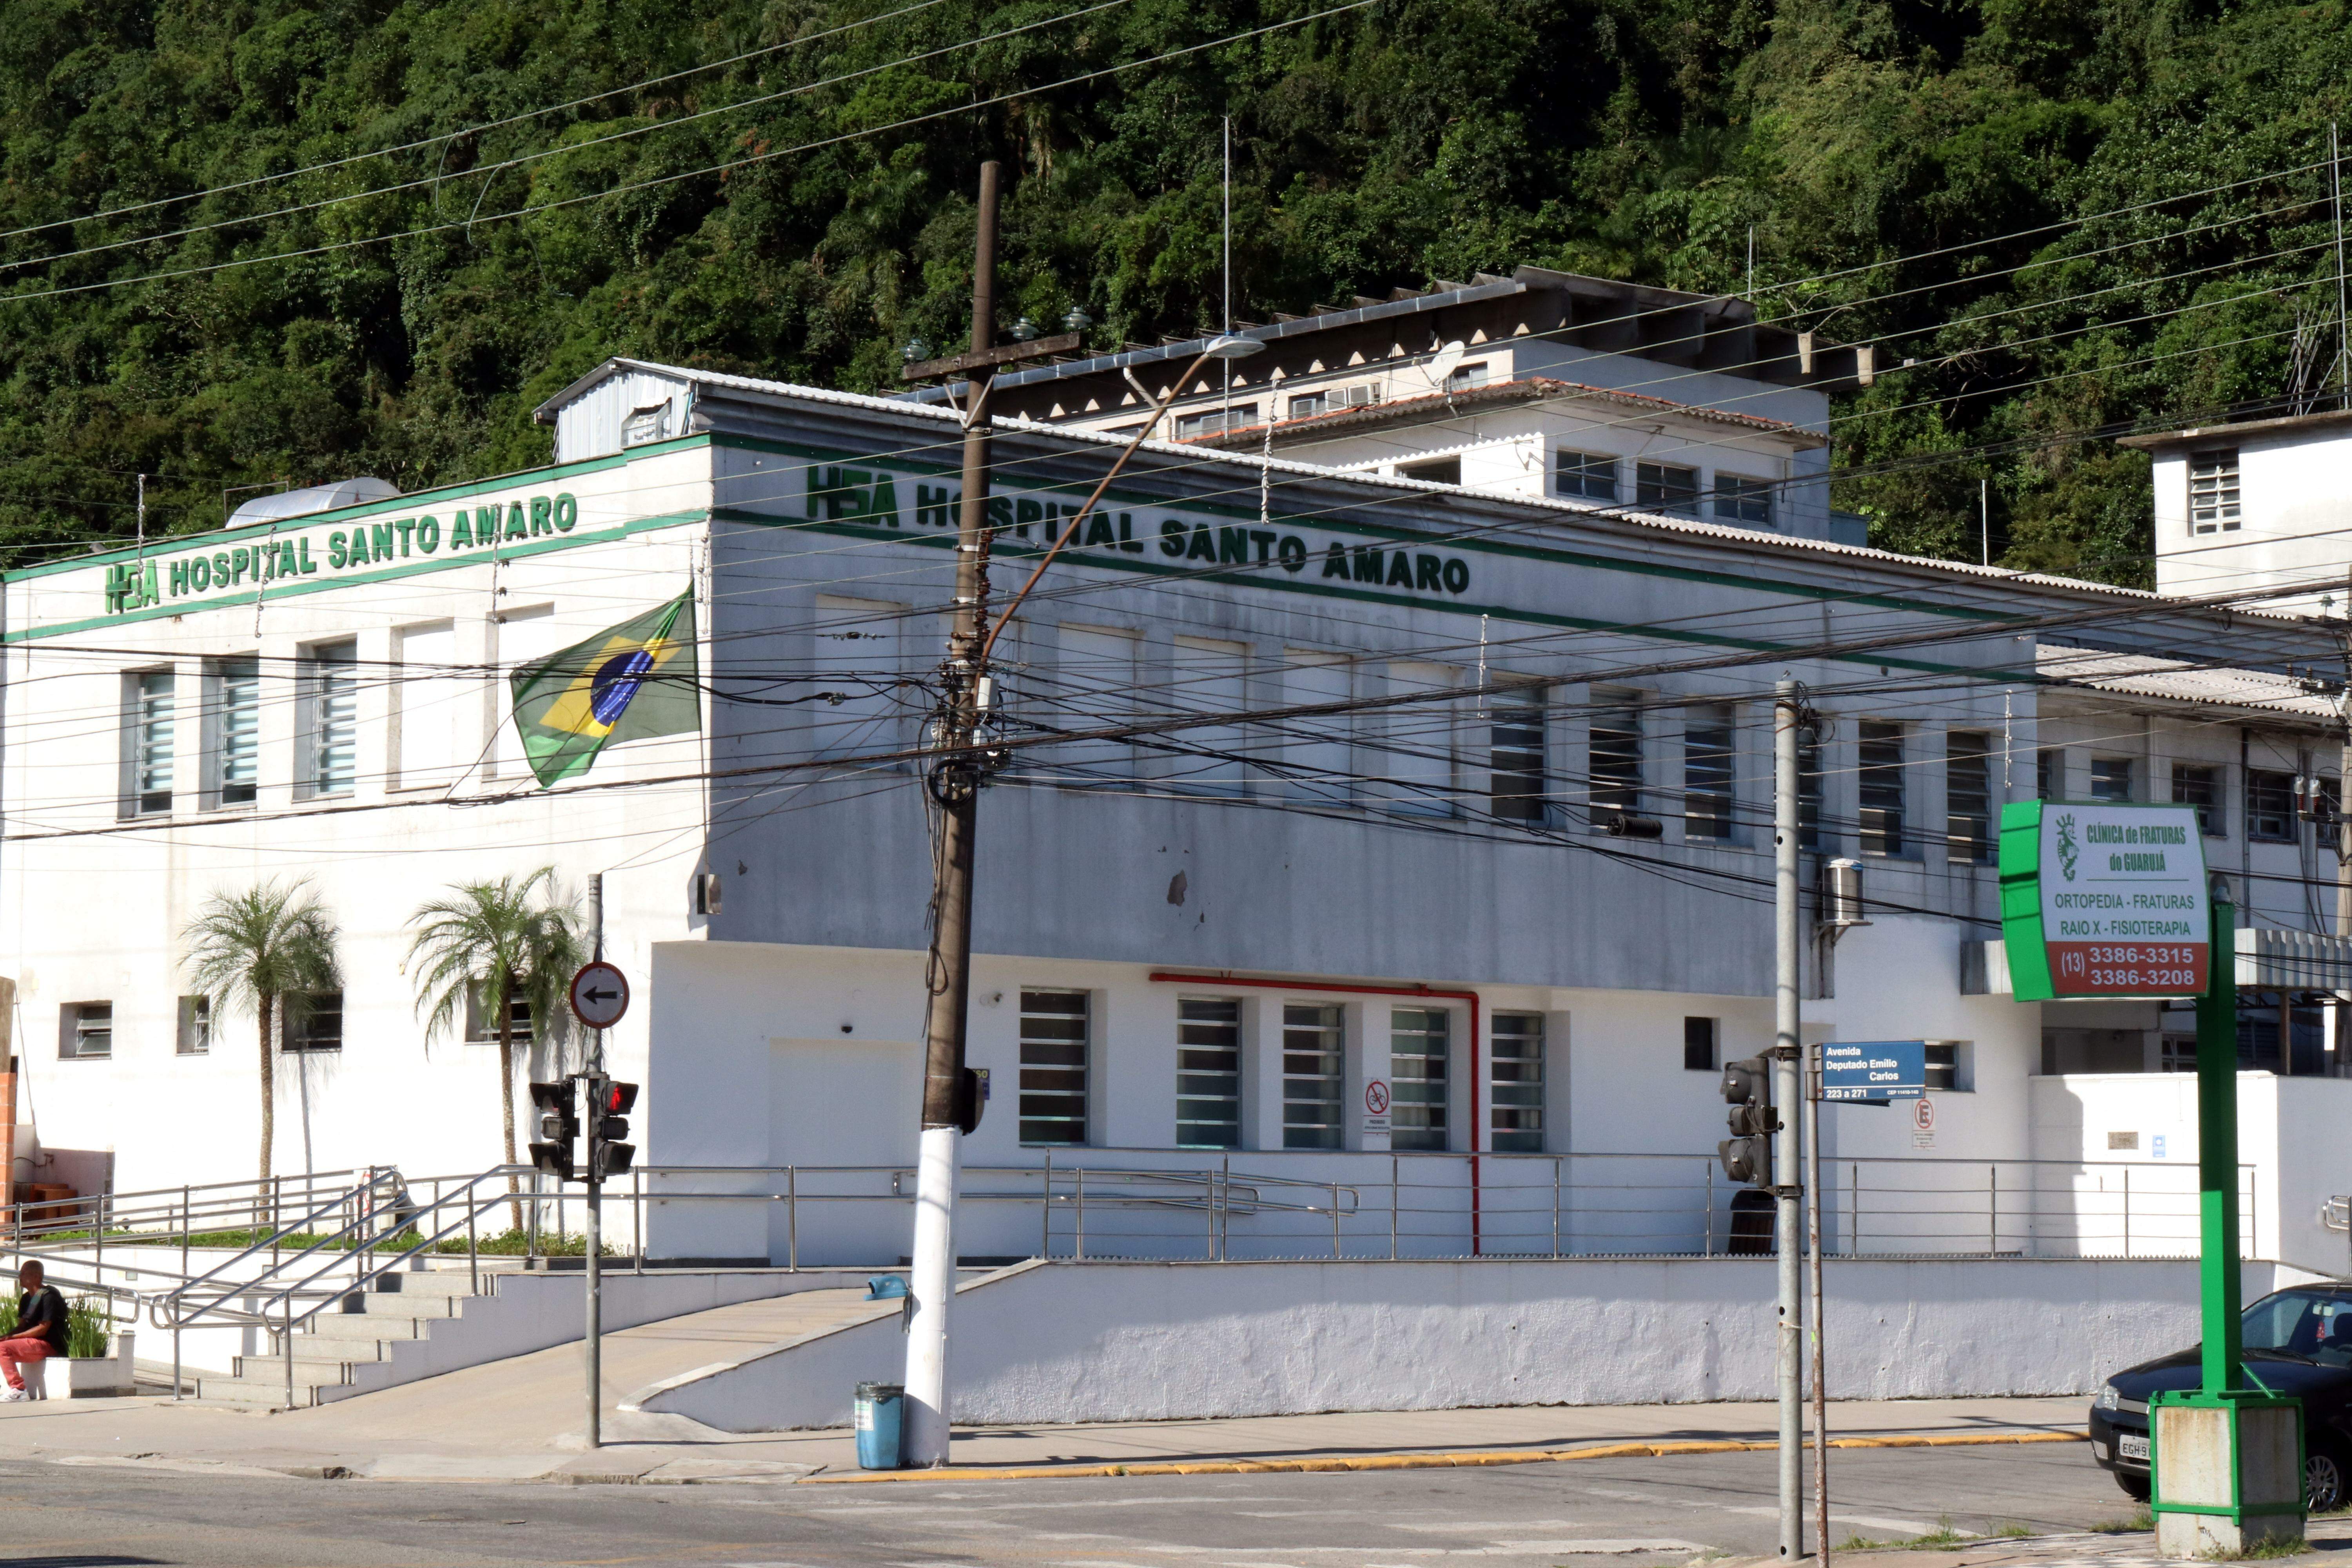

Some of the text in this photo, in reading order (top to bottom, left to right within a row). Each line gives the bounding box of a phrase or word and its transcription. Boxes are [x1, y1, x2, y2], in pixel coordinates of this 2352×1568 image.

[169, 537, 317, 597] HOSPITAL
[328, 515, 440, 568] SANTO
[450, 493, 577, 549] AMARO
[917, 484, 1143, 552] HSPITAL
[1160, 519, 1306, 572] SANTO
[1323, 543, 1469, 593] AMARO
[2087, 822, 2186, 845] CLÍNICA de FRATURAS
[2109, 850, 2165, 872] do GUARUJÁ
[2055, 894, 2122, 909] ORTOPEDIA
[2134, 895, 2194, 909] FRATURAS
[2061, 921, 2090, 935] RAIO
[2093, 921, 2100, 935] X
[2111, 921, 2190, 935] FISIOTERAPIA
[2062, 947, 2193, 977] (13) 3386-3315
[2091, 970, 2194, 985] 3386-3208
[1826, 1047, 1861, 1056] Avenida
[1826, 1059, 1897, 1071] Deputado Emílio
[1869, 1072, 1899, 1081] Carlos
[1827, 1090, 1842, 1098] 223
[1851, 1089, 1867, 1098] 271
